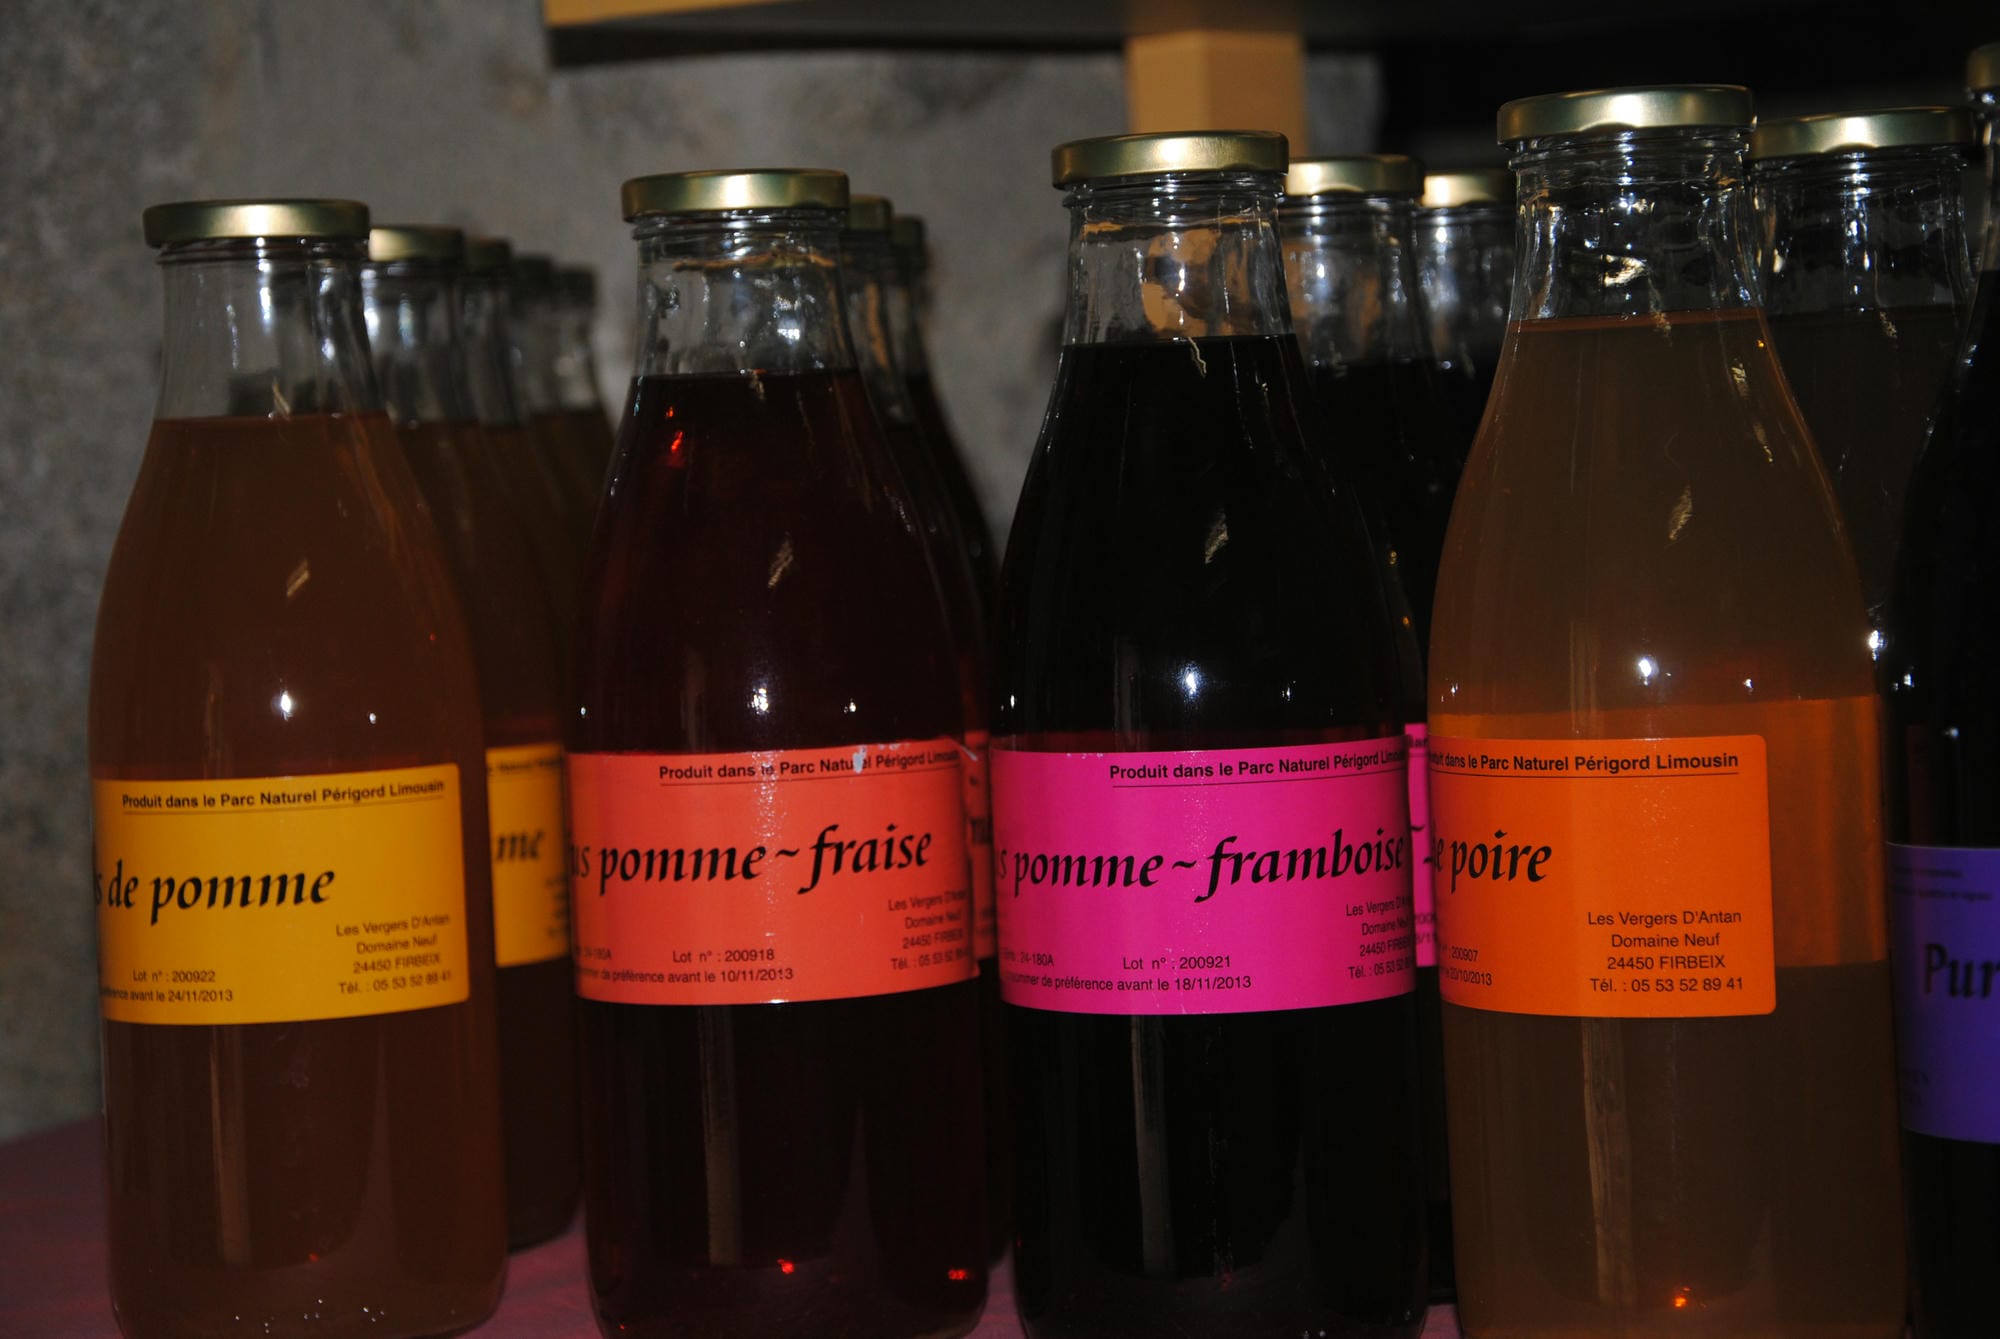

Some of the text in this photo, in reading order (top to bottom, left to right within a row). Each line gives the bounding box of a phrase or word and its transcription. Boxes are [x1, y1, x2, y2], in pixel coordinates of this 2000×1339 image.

[659, 764, 713, 779] Produit
[717, 763, 756, 777] dans
[779, 760, 815, 775] Parc
[820, 755, 871, 773] Natuel
[876, 752, 925, 769] Périgord
[1110, 764, 1168, 779] Produit
[1173, 764, 1214, 778] dans
[1219, 762, 1233, 776] le
[1239, 761, 1274, 774] Parc
[1279, 756, 1329, 772] Naturel
[1334, 752, 1379, 770] Périgord
[1445, 753, 1465, 768] dans
[1468, 754, 1477, 768] le
[1481, 754, 1508, 769] Parc
[1514, 756, 1568, 770] Naturel
[1575, 755, 1650, 774] Périgord
[1657, 753, 1738, 769] Limousin
[122, 779, 445, 808] Produit dans le Parc Naturel Périgord Limousin
[1450, 829, 1552, 895] poire
[108, 858, 139, 909] de
[150, 870, 336, 927] pomme
[888, 899, 907, 911] Les
[1346, 904, 1364, 916] Les
[336, 923, 359, 937] Les
[362, 919, 409, 935] Vergers
[1588, 911, 1742, 928] Les Vergers D'Antan
[356, 932, 438, 955] Domaine Neuf
[1611, 932, 1720, 947] Domaine Neuf
[672, 949, 692, 963] Lot
[724, 948, 775, 962] 200918
[1360, 941, 1385, 957] 24450
[1451, 945, 1479, 962] 200907
[353, 958, 391, 974] 24450
[1123, 957, 1143, 969] Lot
[1179, 954, 1231, 969] 200921
[1607, 955, 1726, 970] 24450 FIRBEIX
[132, 968, 147, 982] Lot
[171, 970, 216, 983] 200922
[612, 969, 664, 984] préférence
[667, 971, 701, 983] avant
[704, 970, 716, 982] le
[721, 967, 794, 982] 10/11/2013
[1347, 965, 1366, 979] Tél.
[1374, 962, 1384, 976] 05
[372, 978, 389, 991] 05
[392, 975, 407, 989] 53
[1041, 974, 1053, 987] de
[1055, 976, 1113, 991] préférence
[1117, 979, 1152, 991] avant
[1157, 978, 1169, 990] le
[1175, 975, 1251, 990] 18/11/2013
[1590, 978, 1617, 992] Tél.
[1631, 978, 1650, 992] 05
[1655, 978, 1674, 992] 53
[1679, 978, 1698, 992] 52
[1703, 977, 1722, 991] 89
[1727, 977, 1743, 990] 41
[130, 990, 153, 1001] avant
[156, 990, 166, 1001] le
[168, 988, 233, 1002] 24/11/2013
